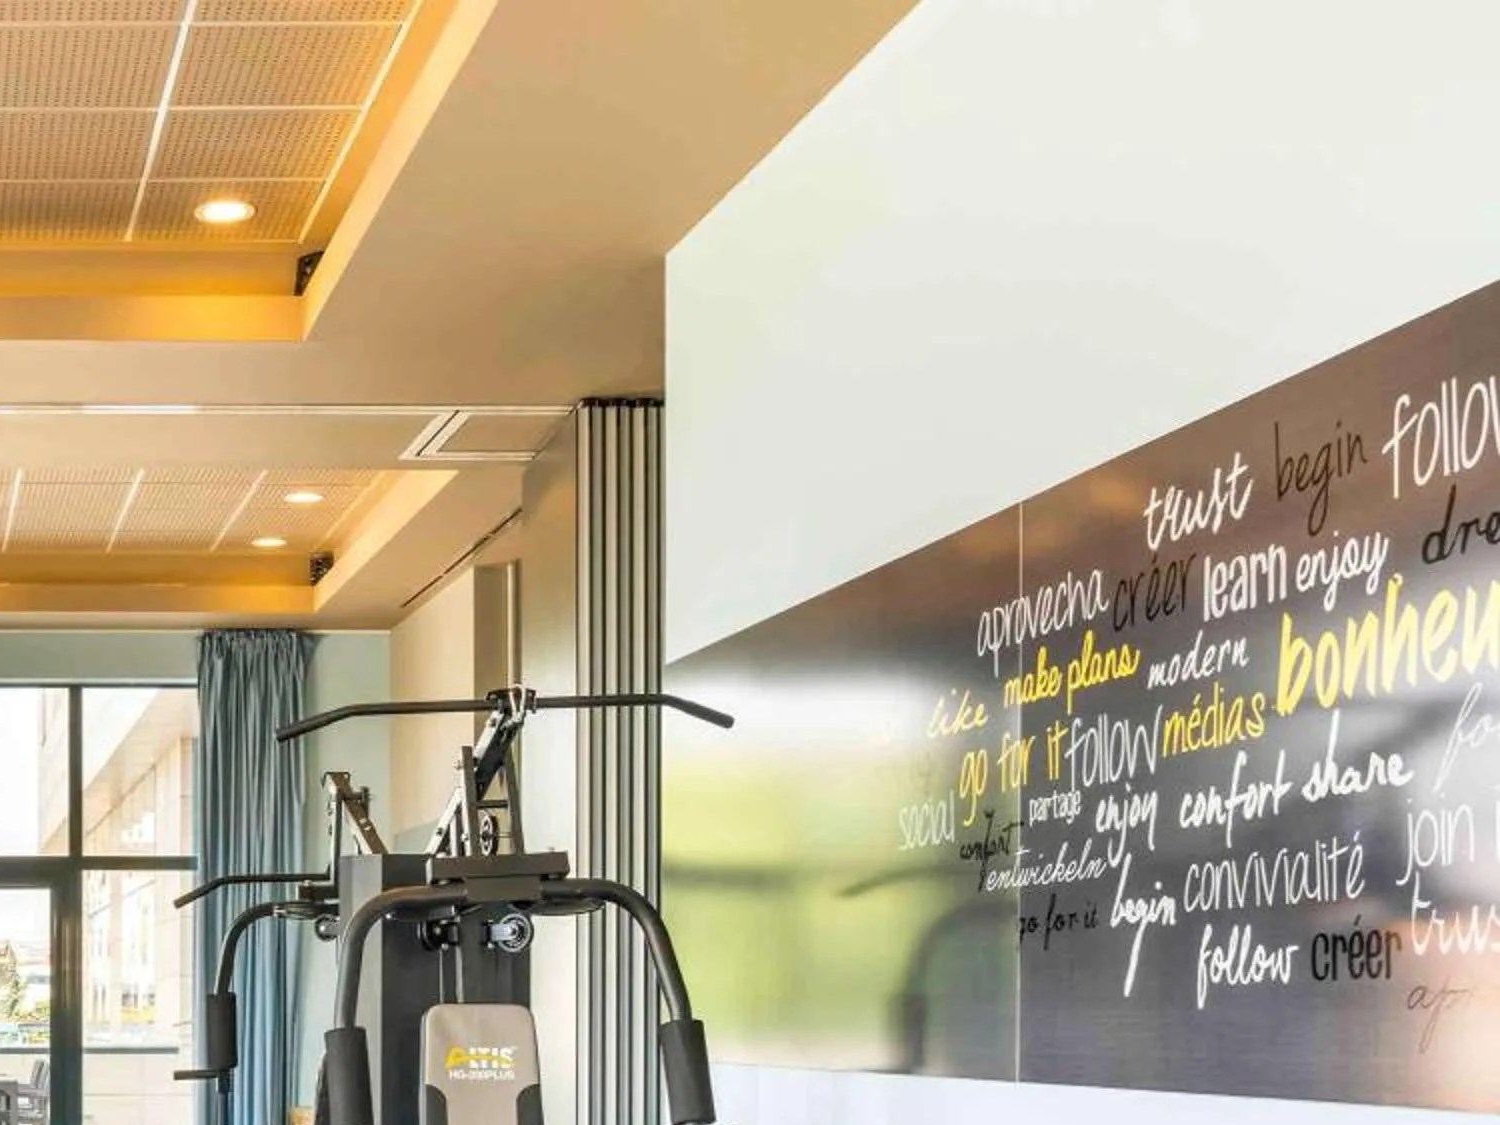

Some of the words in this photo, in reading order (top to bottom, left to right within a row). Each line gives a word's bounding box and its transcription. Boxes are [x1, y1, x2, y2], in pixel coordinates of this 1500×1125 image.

[1143, 452, 1254, 550] trust
[1273, 421, 1367, 536] begin
[1112, 553, 1197, 633] créer
[1204, 544, 1288, 622] learn
[1296, 531, 1389, 612] enjoy
[977, 568, 1108, 678] aprovecha
[1148, 630, 1249, 690] modern
[927, 687, 989, 739] like
[1004, 645, 1062, 708] make
[1067, 630, 1140, 716] plans
[1065, 704, 1163, 791] follow
[1163, 681, 1266, 758] médias
[1302, 709, 1415, 801] share
[959, 749, 988, 827] go
[998, 731, 1036, 792] for
[1046, 720, 1068, 781] it
[1029, 790, 1081, 827] partage
[1180, 750, 1294, 848] confort
[899, 789, 956, 851] social
[1096, 782, 1158, 868] enjoy
[1396, 792, 1475, 886] join
[986, 837, 1108, 892] entwickeln
[1184, 831, 1365, 912] convivialité
[1110, 852, 1177, 998] begin
[1311, 914, 1402, 981] créer
[1197, 925, 1299, 1010] follow
[445, 1047, 516, 1069] ALTIS
